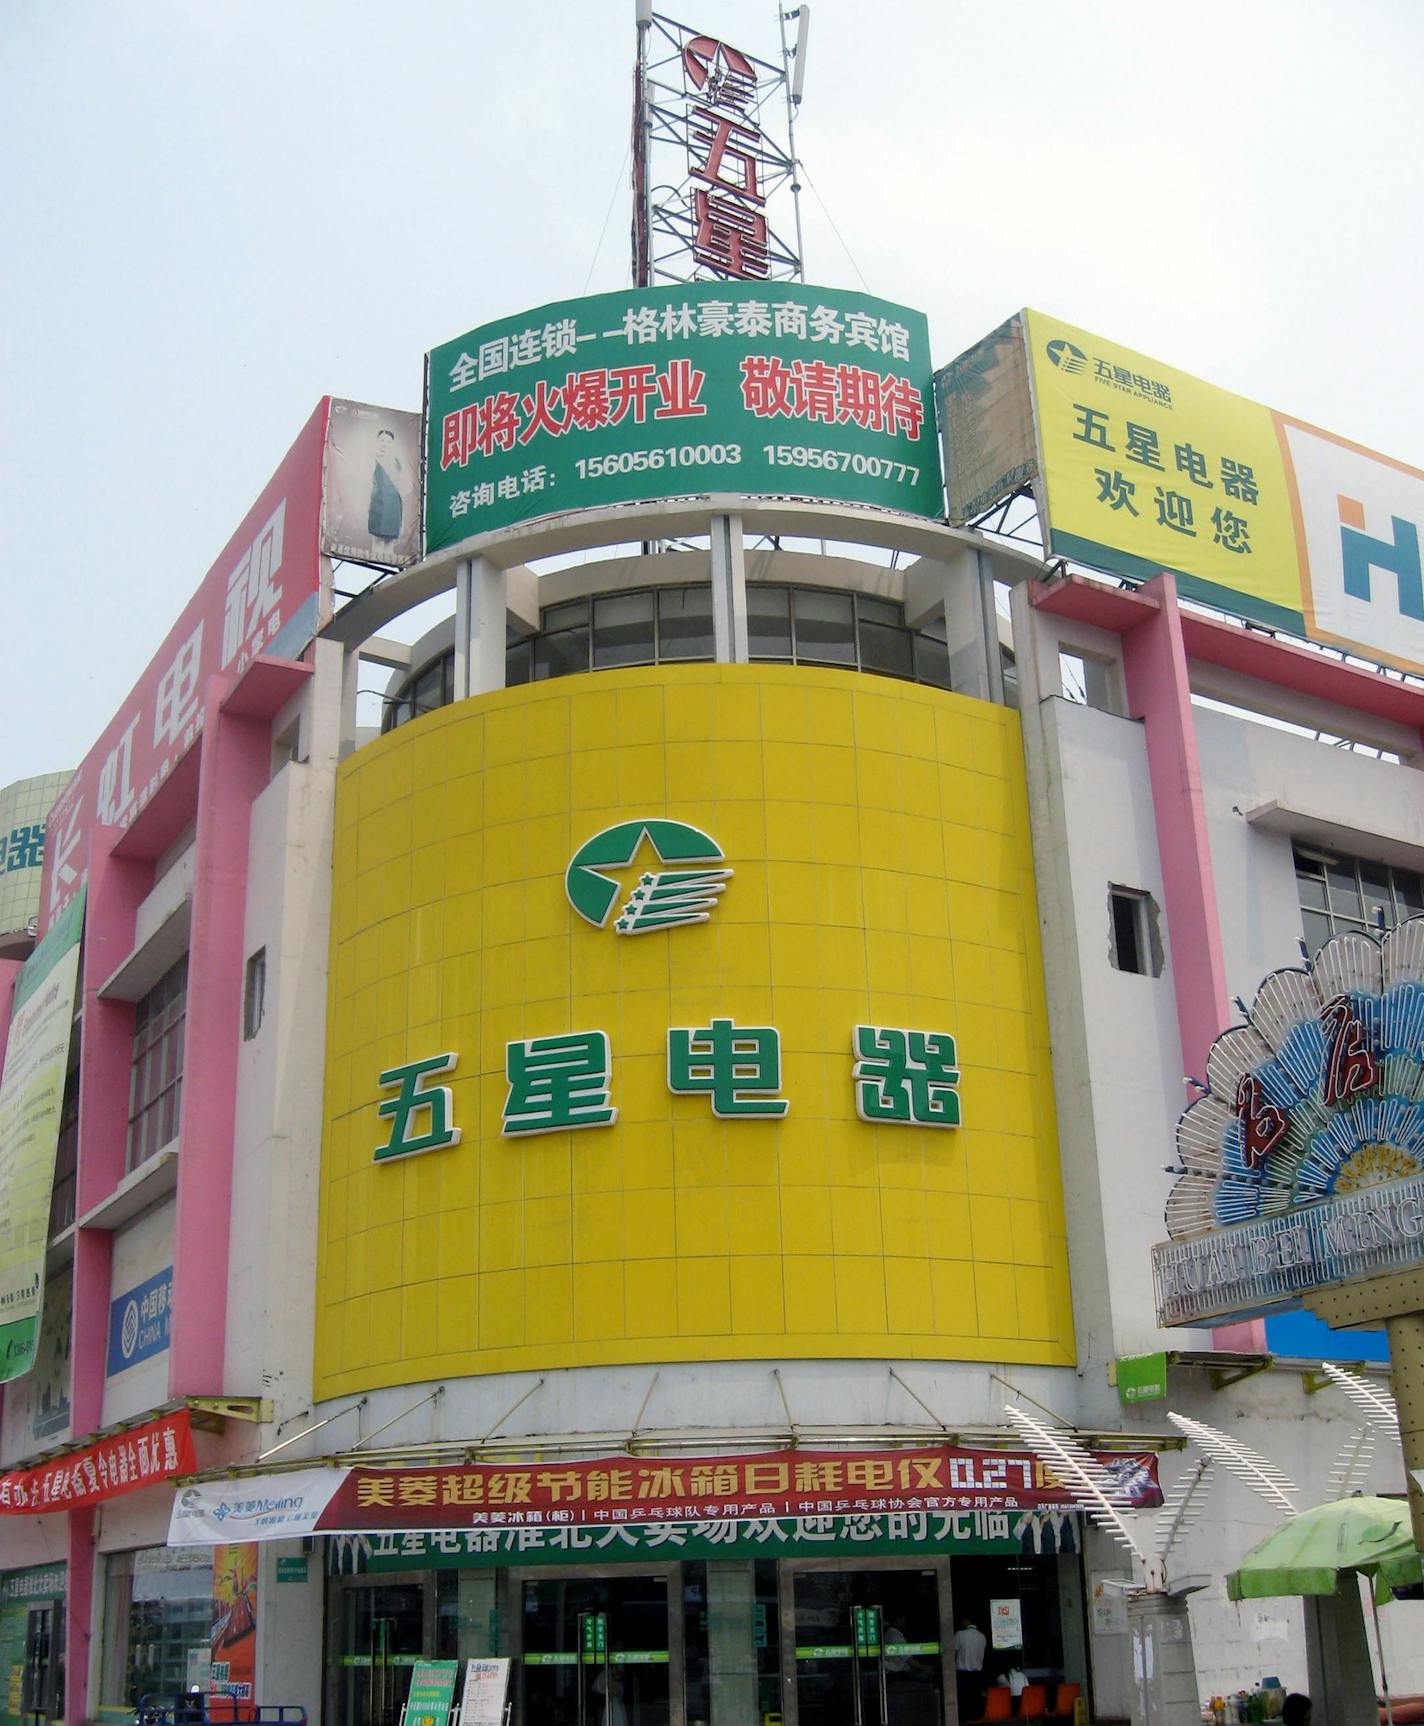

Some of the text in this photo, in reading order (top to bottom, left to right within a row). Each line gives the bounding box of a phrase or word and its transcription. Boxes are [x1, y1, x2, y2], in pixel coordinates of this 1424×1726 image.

[440, 355, 924, 471] 即将火爆开业 敬请期待
[1093, 357, 1172, 403] 五星电器
[1094, 375, 1172, 410] FIVE STAR APPLIANCE
[449, 444, 920, 517] 咨询电话: 15605610003 15956700777
[1072, 403, 1259, 506] 五星电器
[1094, 467, 1253, 555] 欢迎您
[373, 1017, 962, 1164] 五星电器
[1159, 1245, 1243, 1298] HUAI
[1250, 1225, 1310, 1275] BEI
